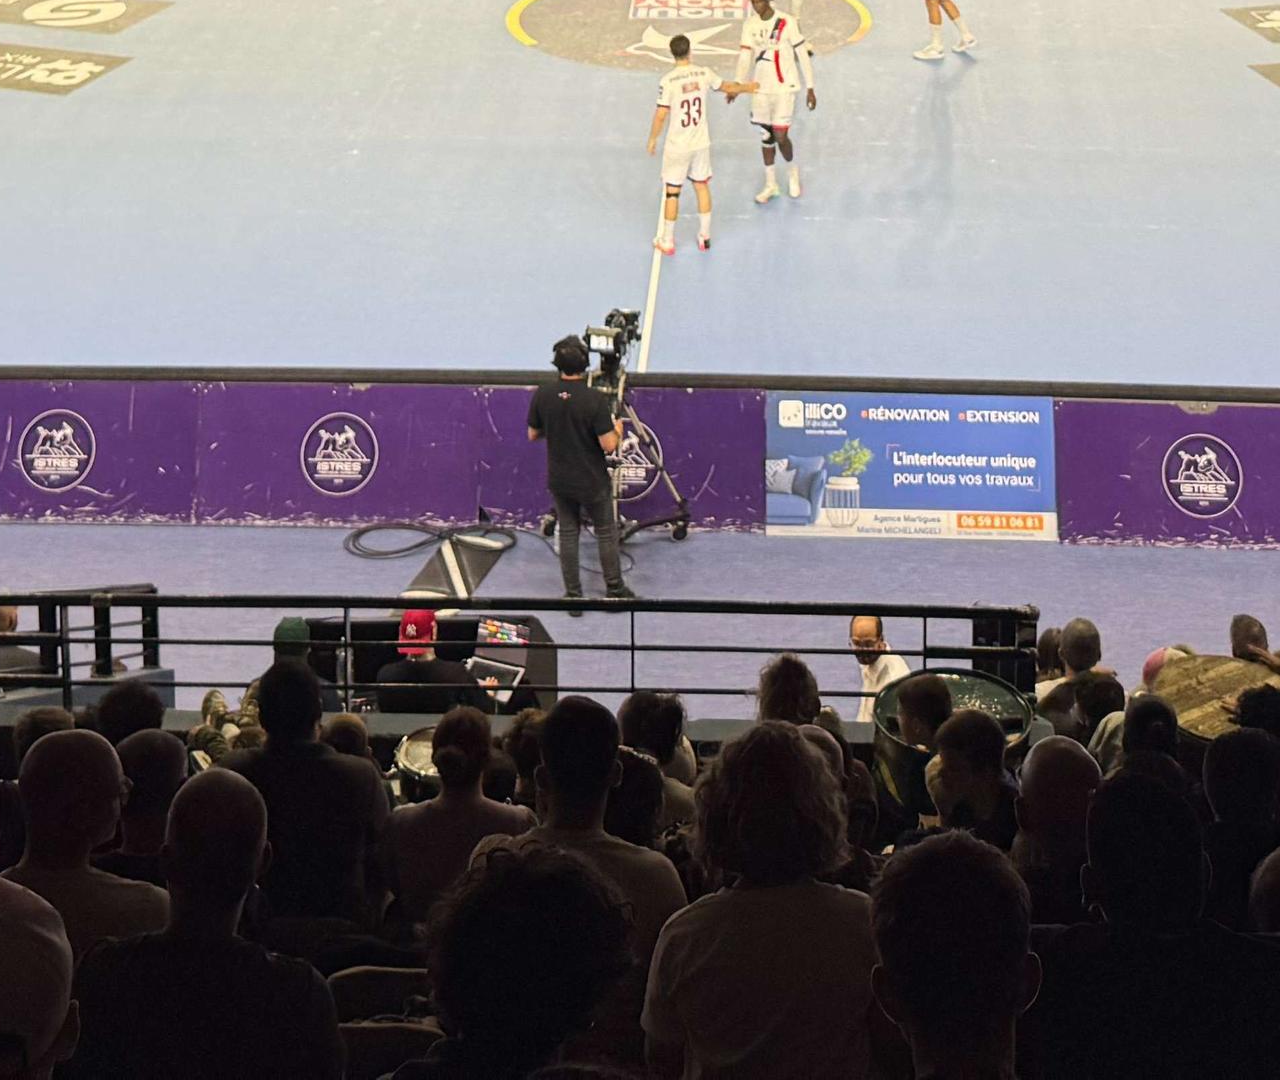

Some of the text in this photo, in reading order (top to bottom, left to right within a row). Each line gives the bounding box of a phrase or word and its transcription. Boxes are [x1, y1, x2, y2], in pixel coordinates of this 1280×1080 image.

[680, 97, 702, 128] 33
[869, 405, 950, 421] RÉNOVATION
[966, 410, 1040, 424] EXTENSION
[34, 459, 78, 470] ISTRES
[317, 461, 361, 473] ISTRES
[893, 451, 1036, 471] L'interlocuteur unique
[620, 467, 646, 478] RES
[894, 472, 1034, 487] pour tous vos travaux
[1181, 483, 1226, 494] ISTRES
